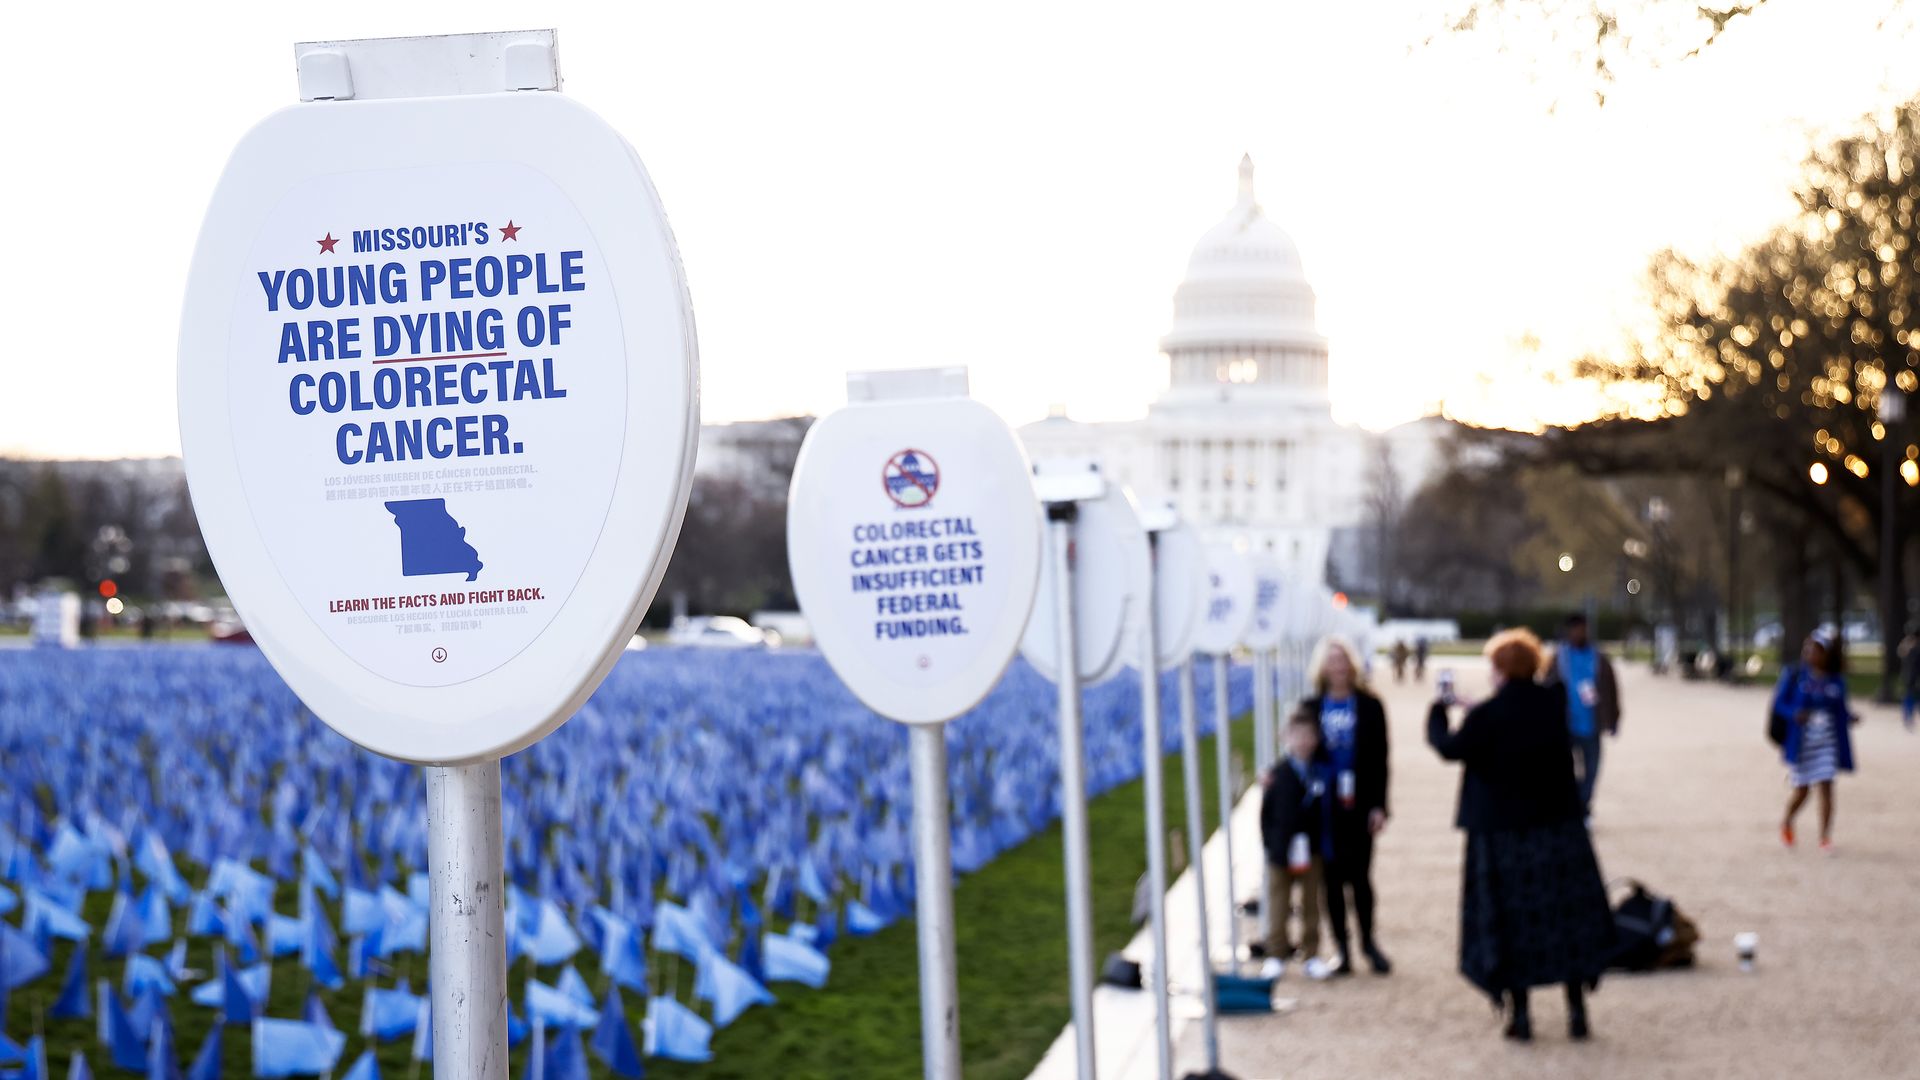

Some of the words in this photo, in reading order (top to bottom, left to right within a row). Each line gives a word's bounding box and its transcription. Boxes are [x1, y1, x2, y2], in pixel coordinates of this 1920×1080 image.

[352, 222, 489, 253] MISSOURI'S
[257, 262, 407, 311] YOUNG
[420, 250, 586, 301] PEOPLE
[277, 318, 362, 363] ARE
[373, 308, 505, 357] DYING
[517, 304, 571, 347] OF
[289, 357, 567, 415] COLORECTAL
[336, 414, 524, 465] CANCER.
[324, 476, 342, 486] LOS
[342, 474, 381, 486] JÓVENES
[383, 471, 420, 482] MUEREN
[422, 470, 434, 480] DE
[435, 467, 471, 480] CÁNCER
[473, 465, 538, 477] COLORRECTAL.
[853, 517, 977, 543] COLORECTAL
[851, 545, 928, 568] CANCER
[933, 541, 983, 562] GETS
[851, 565, 984, 592] INSUFFICIENT
[329, 599, 370, 613] LEARN
[372, 597, 396, 610] THE
[398, 594, 438, 608] FACTS
[440, 592, 466, 606] AND
[468, 590, 505, 604] FIGHT
[507, 587, 545, 602] BACK.
[876, 592, 963, 615] FEDERAL
[347, 614, 389, 625] DESCUBRE
[390, 613, 405, 622] LOS
[406, 611, 438, 621] HECHOS
[440, 610, 445, 619] Y
[446, 609, 472, 619] LUCHA
[473, 607, 506, 617] CONTRA
[875, 616, 969, 640] FUNDING.
